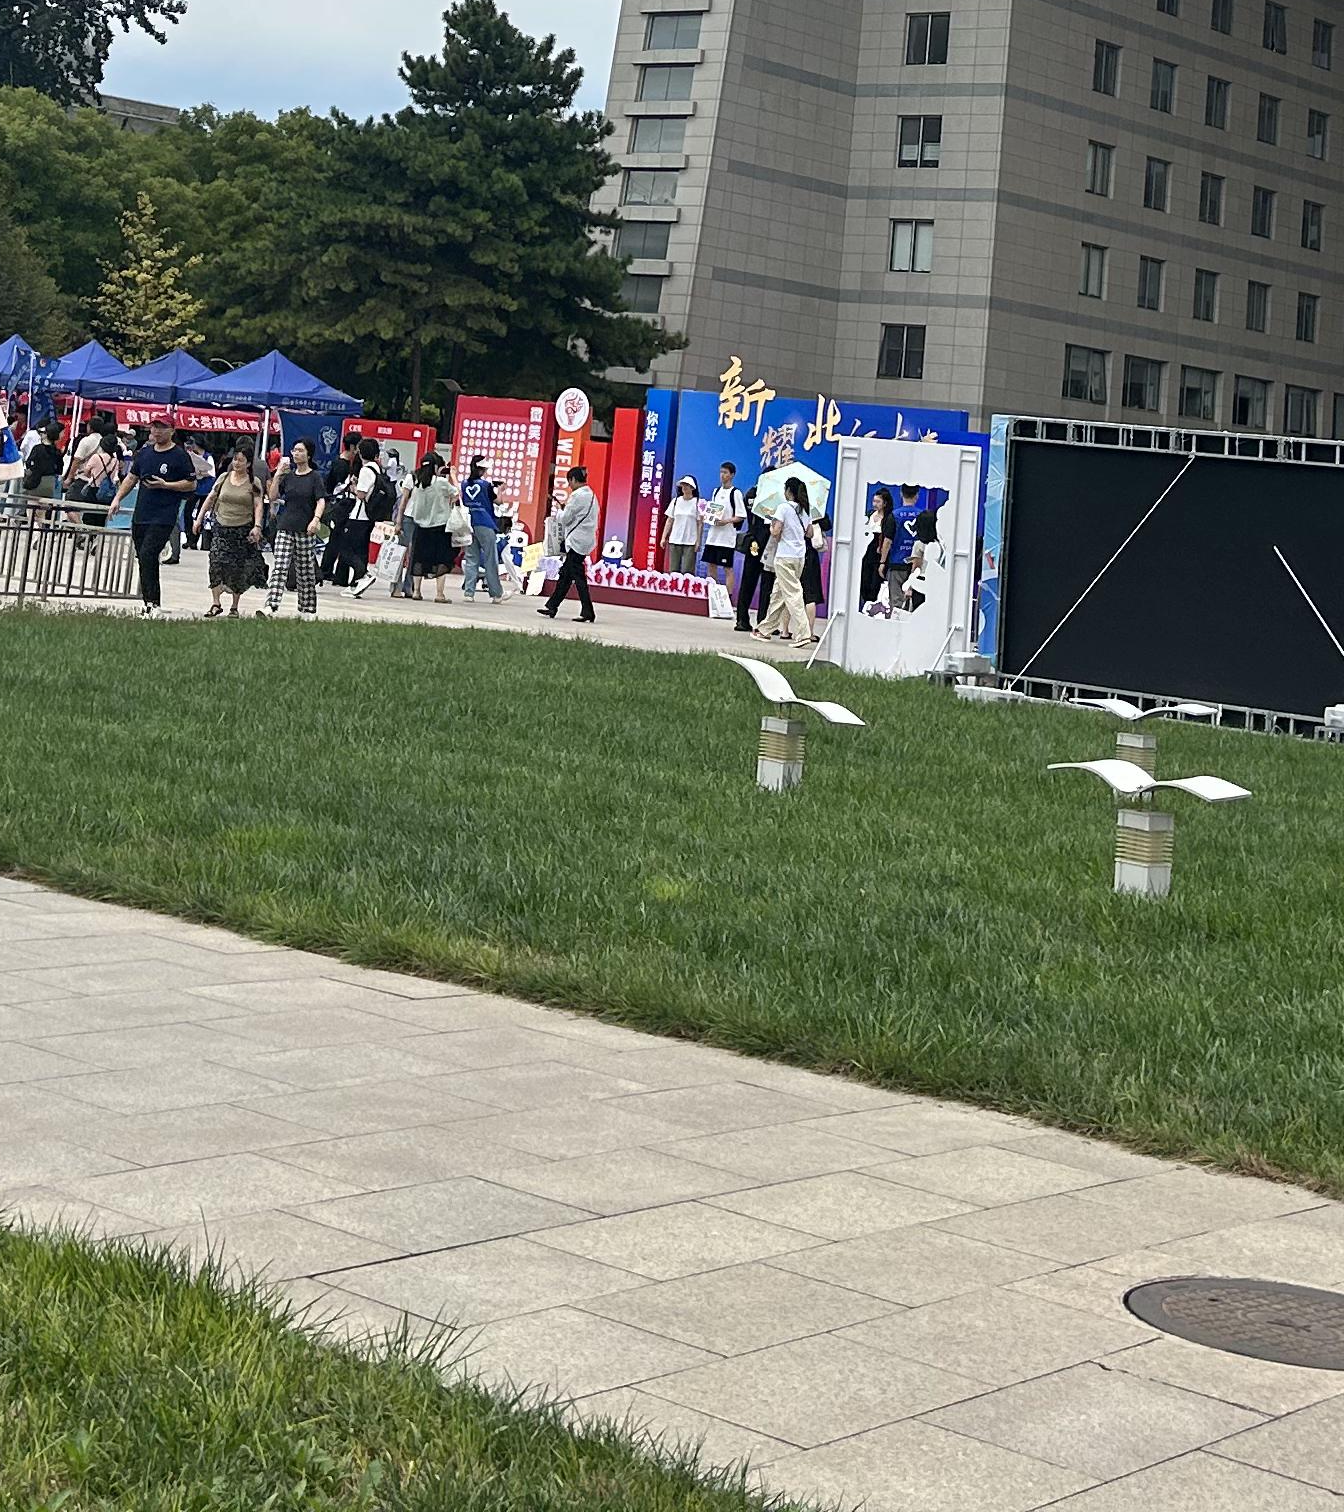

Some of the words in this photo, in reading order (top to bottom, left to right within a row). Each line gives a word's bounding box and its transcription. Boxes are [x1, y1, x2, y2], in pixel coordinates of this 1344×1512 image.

[644, 410, 659, 443] 你好
[639, 450, 656, 498] 新同学
